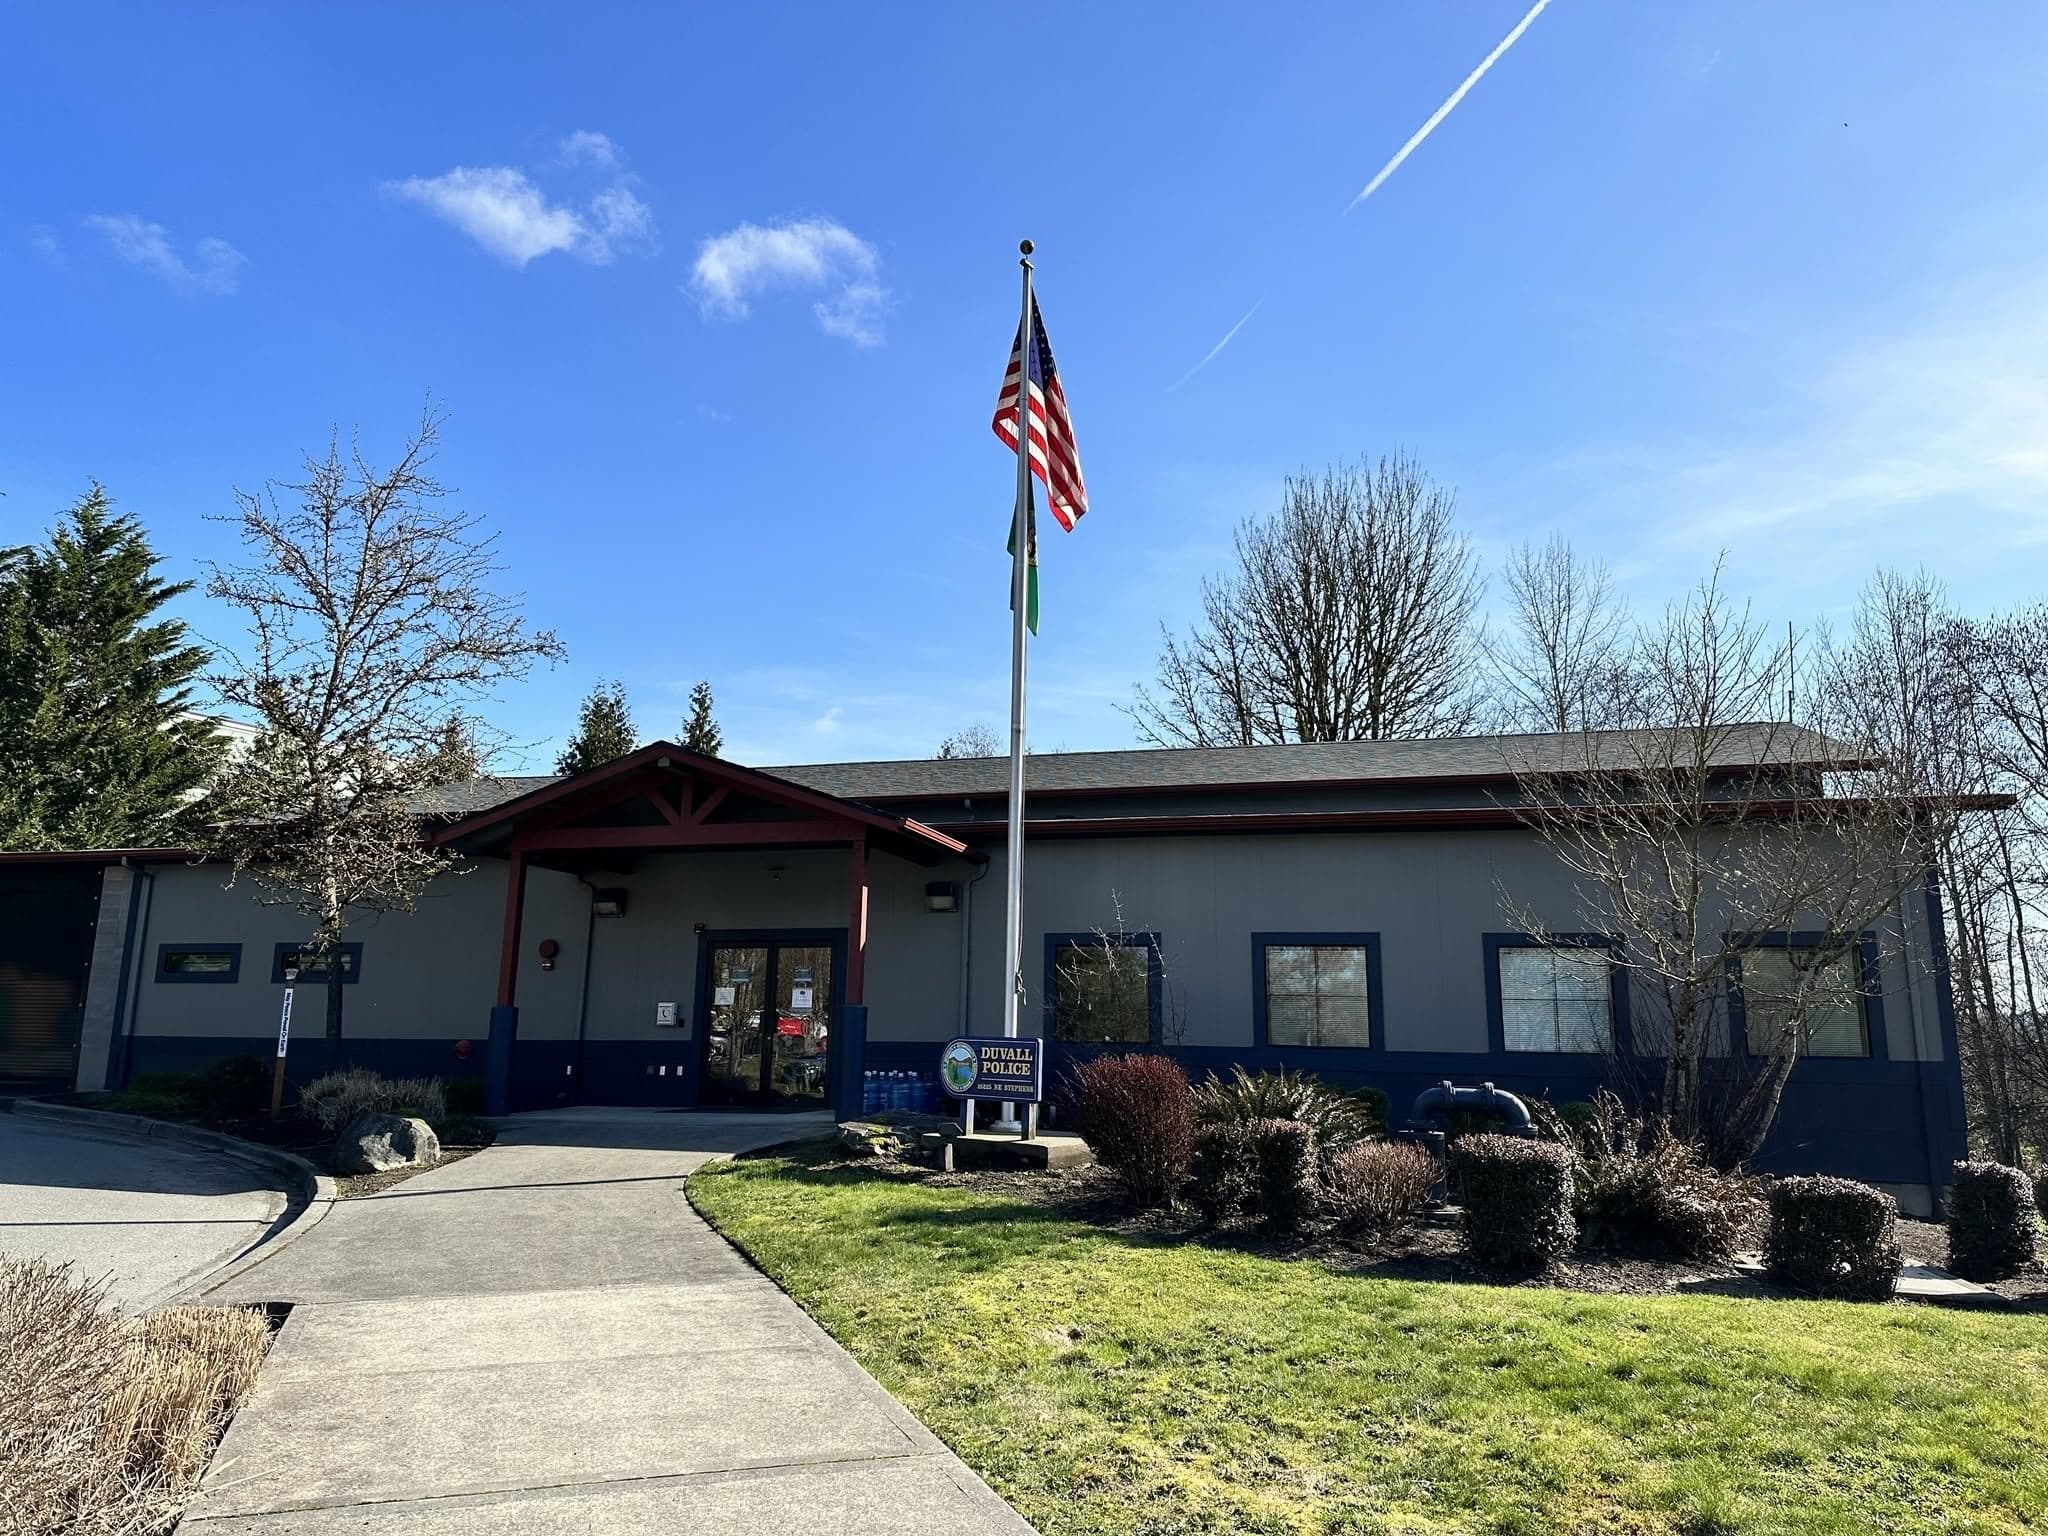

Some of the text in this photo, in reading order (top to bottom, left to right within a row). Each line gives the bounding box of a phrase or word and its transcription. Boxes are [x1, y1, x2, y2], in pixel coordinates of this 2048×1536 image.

[981, 1047, 1033, 1061] DUVALL
[982, 1061, 1031, 1075] POLICE
[1004, 1084, 1033, 1093] STEPHENS
